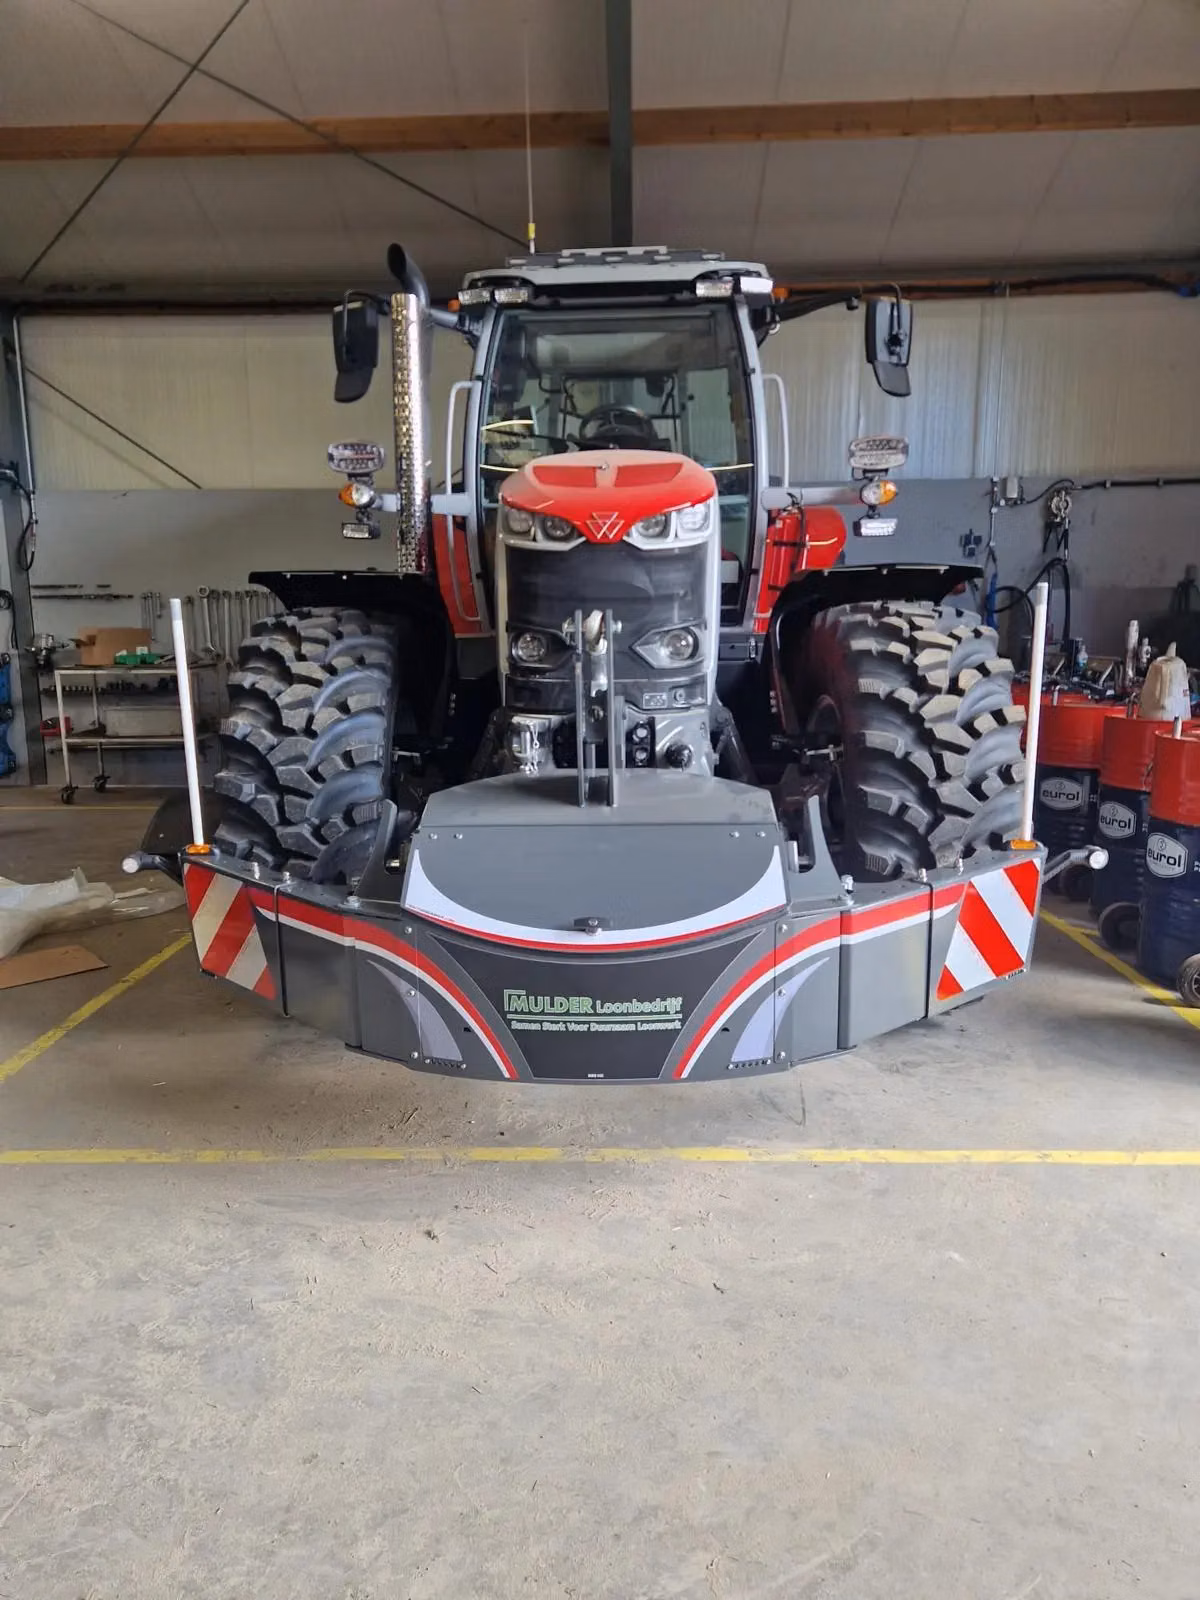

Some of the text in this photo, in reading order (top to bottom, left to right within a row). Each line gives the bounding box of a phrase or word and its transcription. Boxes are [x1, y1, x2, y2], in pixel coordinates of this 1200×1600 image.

[1042, 789, 1080, 801] eurol
[1100, 815, 1131, 829] eurol
[1147, 848, 1182, 867] eurol
[509, 995, 683, 1015] MULDER Loonbedrijf
